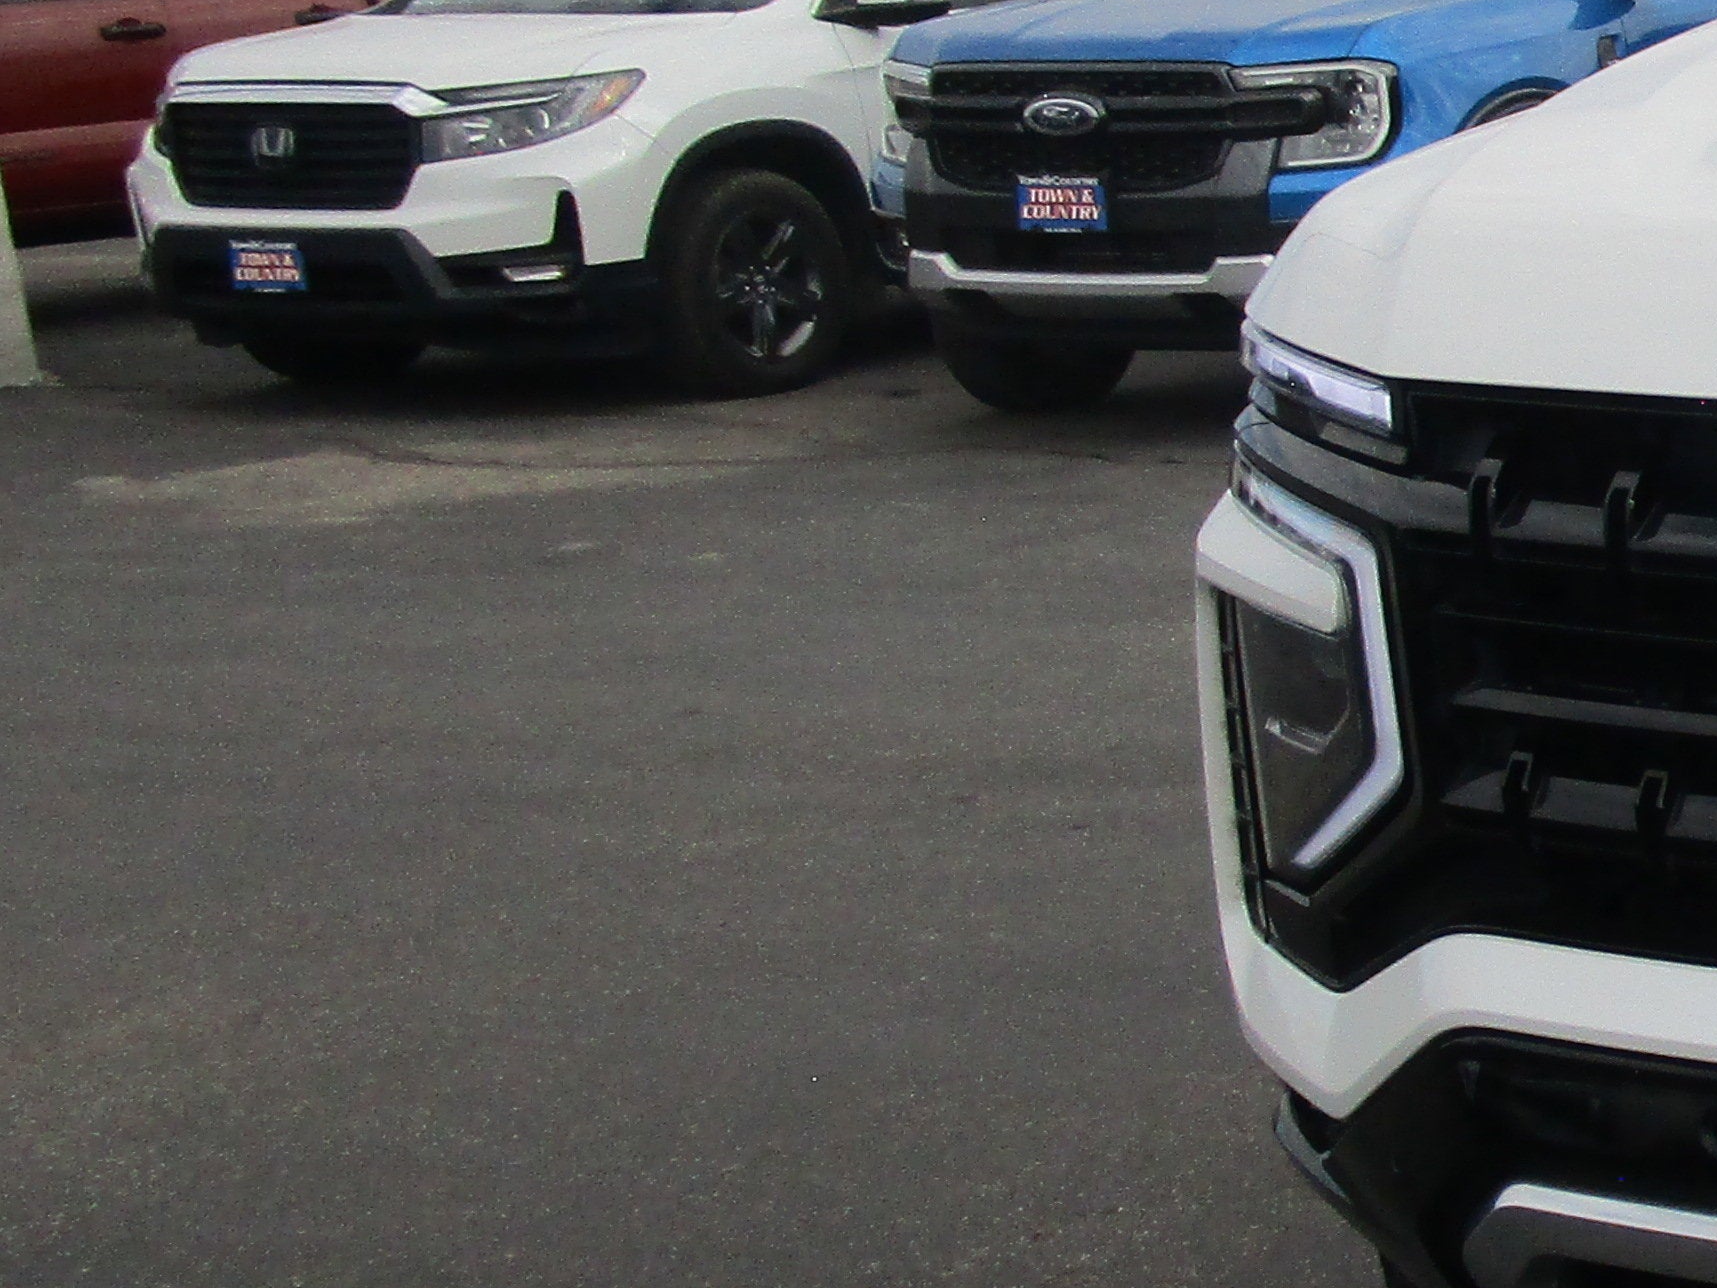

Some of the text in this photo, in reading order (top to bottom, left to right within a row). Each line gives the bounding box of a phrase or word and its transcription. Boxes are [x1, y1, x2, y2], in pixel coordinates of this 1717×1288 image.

[1028, 187, 1095, 204] TOWN &
[1022, 204, 1102, 220] COUNTRY
